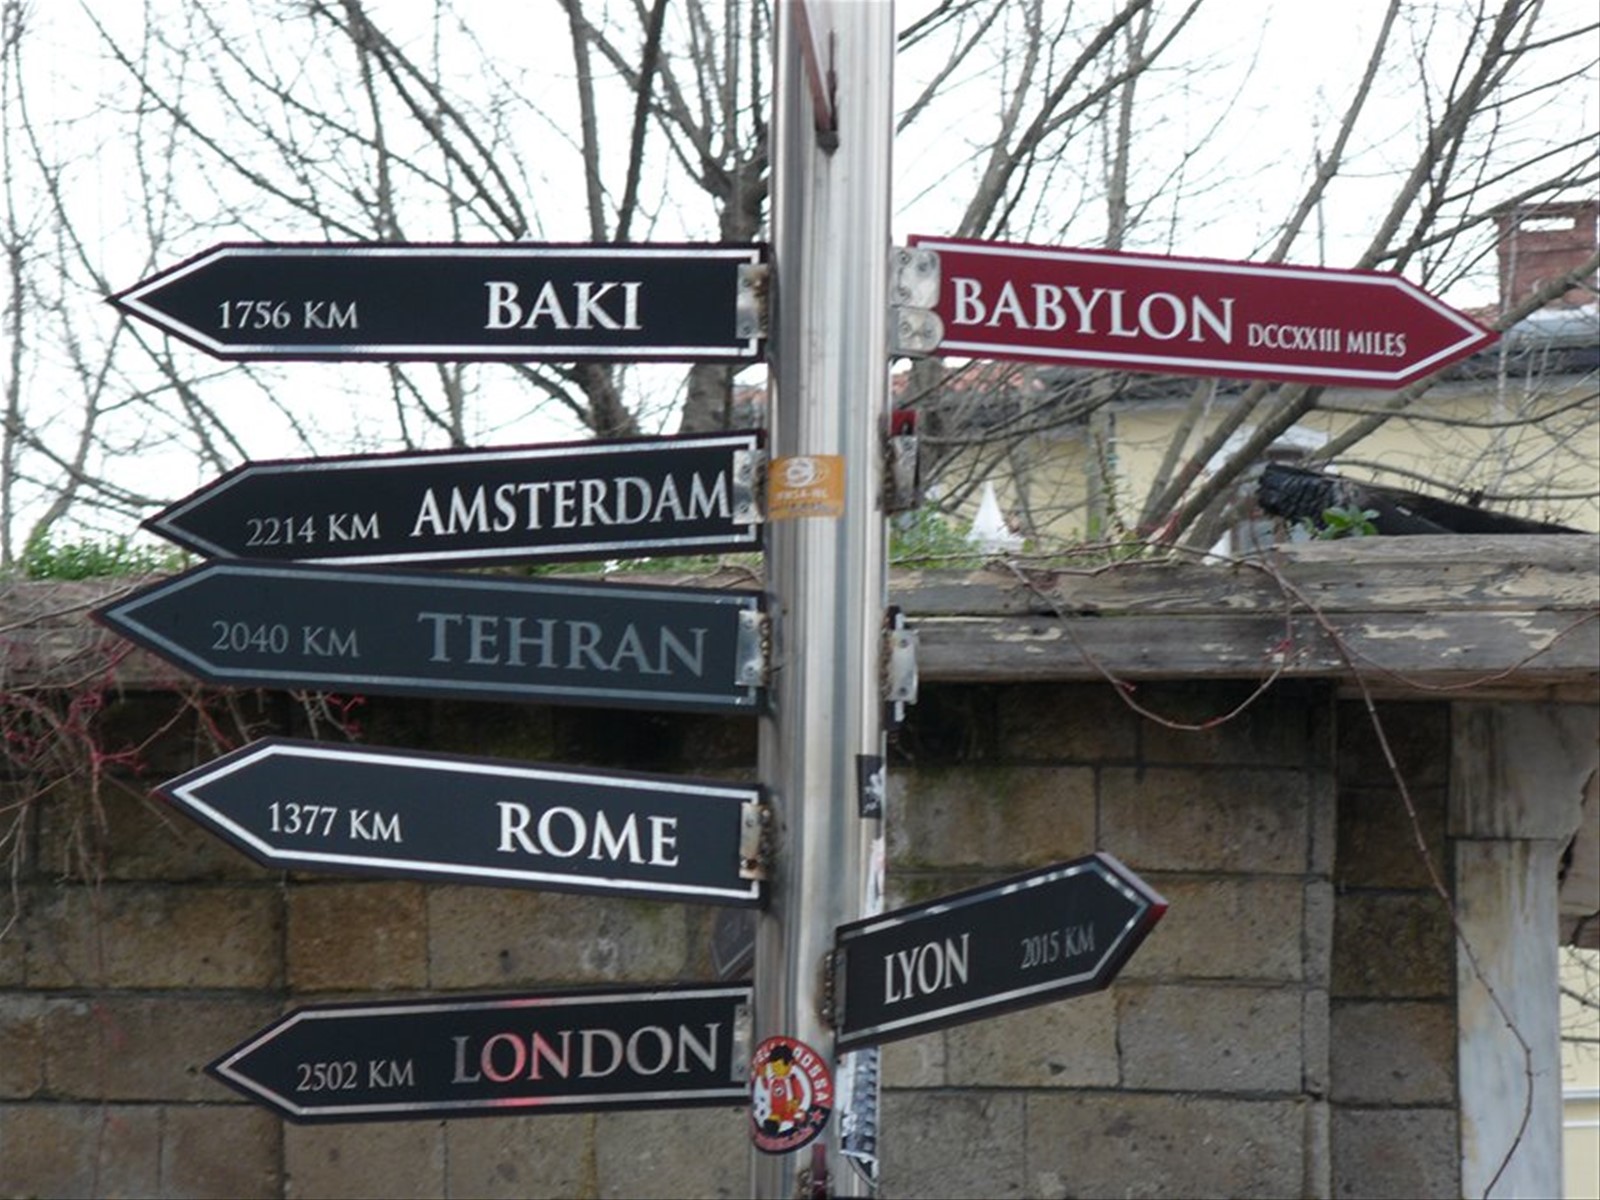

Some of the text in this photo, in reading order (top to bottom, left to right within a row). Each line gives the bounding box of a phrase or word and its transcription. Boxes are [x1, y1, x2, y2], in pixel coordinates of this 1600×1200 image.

[219, 281, 642, 330] 1756 KM BAKI
[951, 277, 1407, 358] BABYLON DCCXXIII MILES
[246, 470, 732, 546] 2214 KM AMSTERDAM
[211, 611, 708, 677] 2040 KM TEHRAN
[267, 801, 680, 868] 1377 KM ROME
[883, 923, 1095, 1005] LYON 2015 KM
[296, 1060, 358, 1093] 2502
[368, 1058, 415, 1088] KM
[452, 1022, 721, 1084] LONDON
